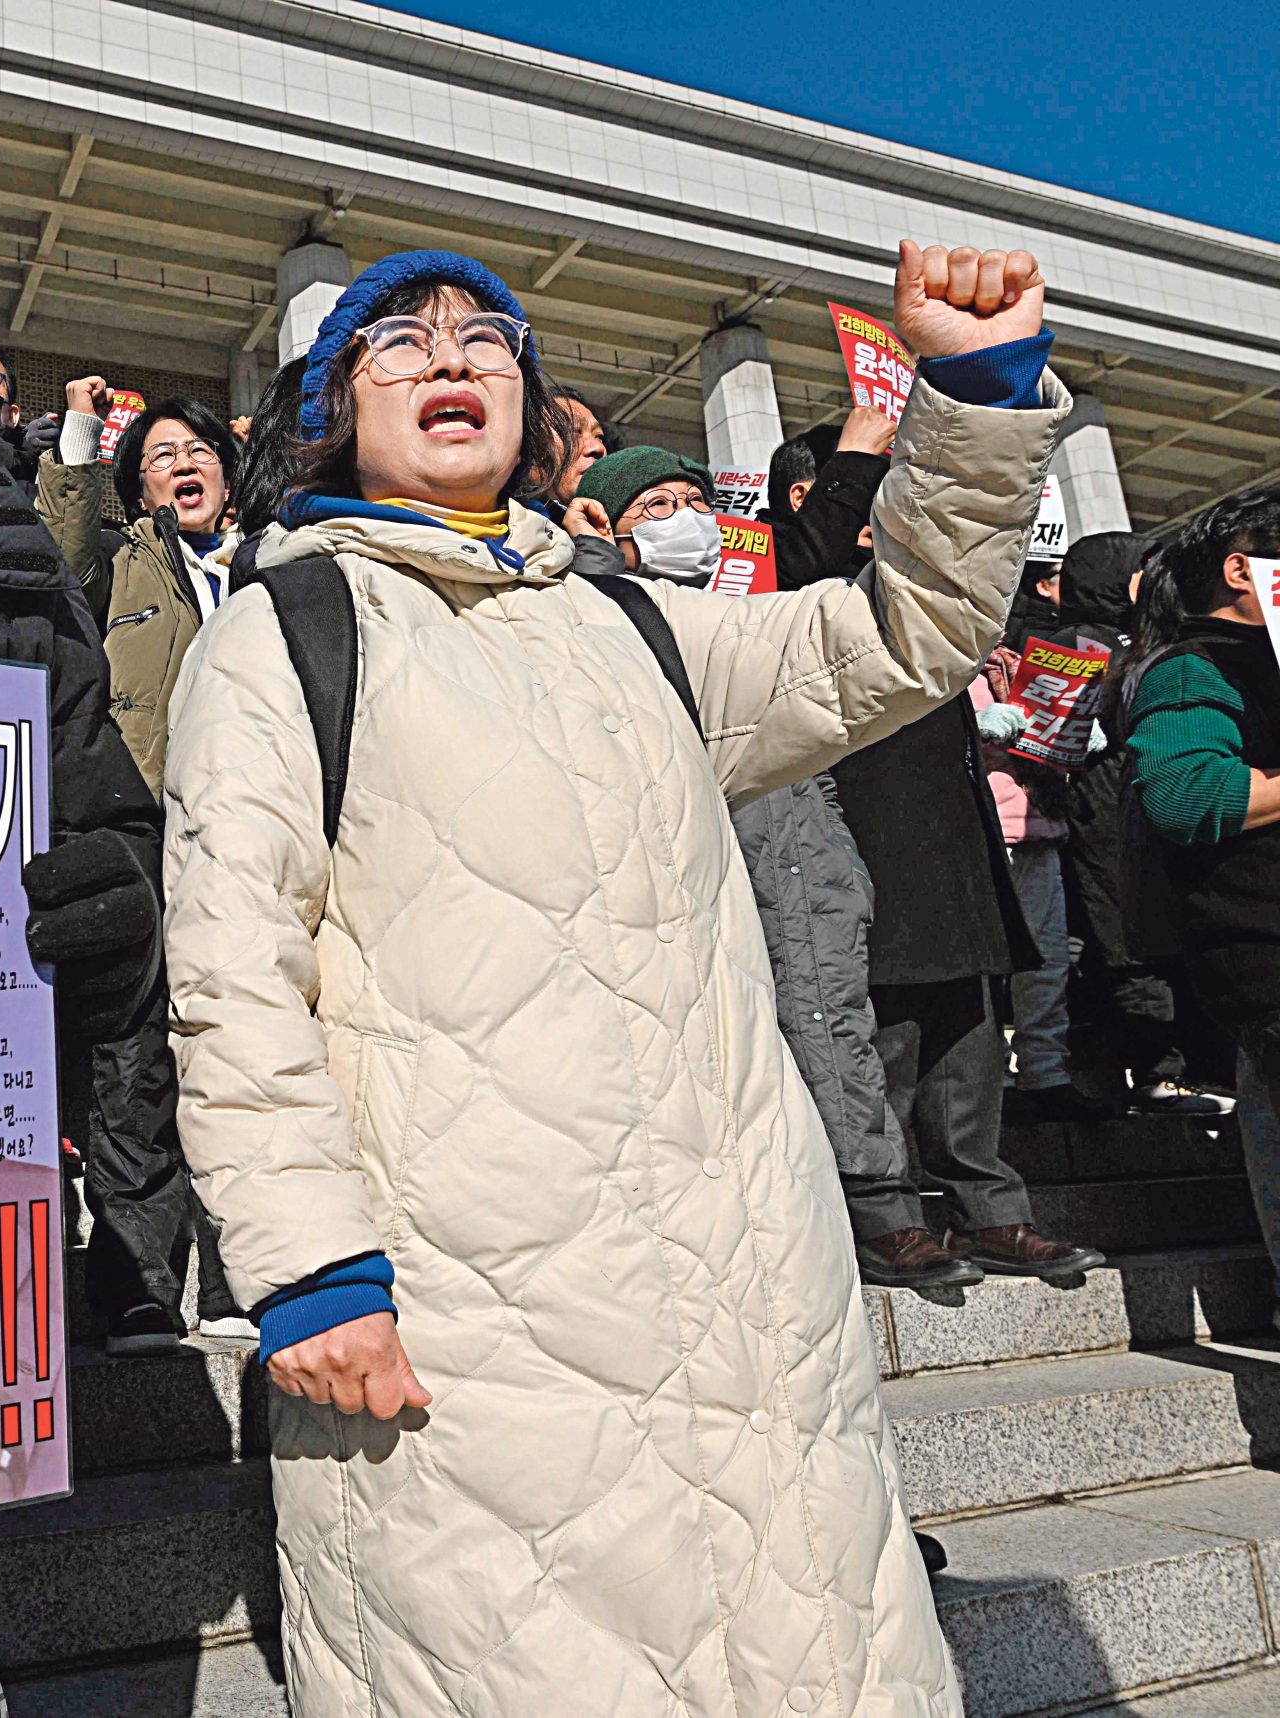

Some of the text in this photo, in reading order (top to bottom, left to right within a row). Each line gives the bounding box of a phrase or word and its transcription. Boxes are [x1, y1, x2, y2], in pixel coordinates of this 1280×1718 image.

[838, 313, 887, 348] 건희방탄
[854, 342, 914, 396] 윤석열
[714, 471, 768, 487] 내란수괴
[717, 525, 769, 556] 라개입
[1032, 523, 1064, 546] 자!
[1026, 647, 1105, 678] 건희방탄
[3, 1070, 34, 1089] 다니고
